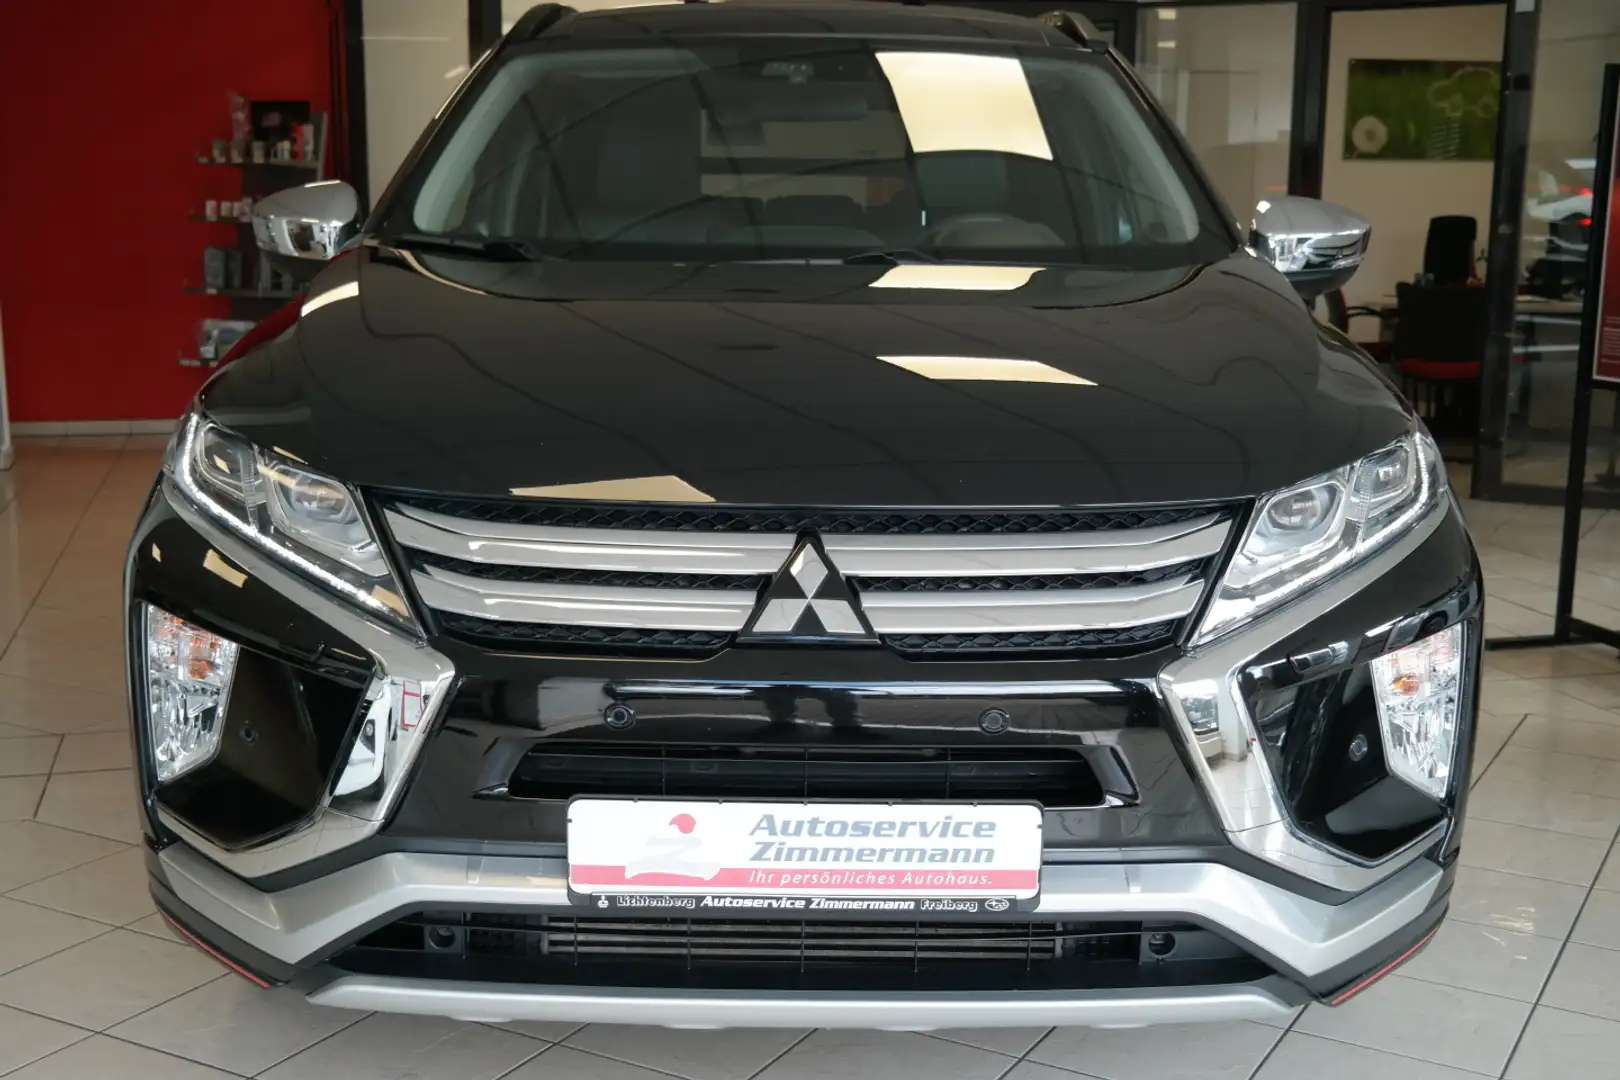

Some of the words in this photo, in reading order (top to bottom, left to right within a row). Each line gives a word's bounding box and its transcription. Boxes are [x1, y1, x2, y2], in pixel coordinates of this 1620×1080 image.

[749, 814, 997, 838] Autoservice
[749, 841, 995, 863] Zimmermann
[749, 869, 774, 884] Ihr
[780, 871, 895, 887] persönliches
[901, 871, 993, 886] Autohaus.
[616, 895, 695, 909] Lichtenberg
[700, 895, 806, 908] Autoservice
[809, 897, 915, 910] Zimmermann
[920, 898, 978, 912] Freiberg
